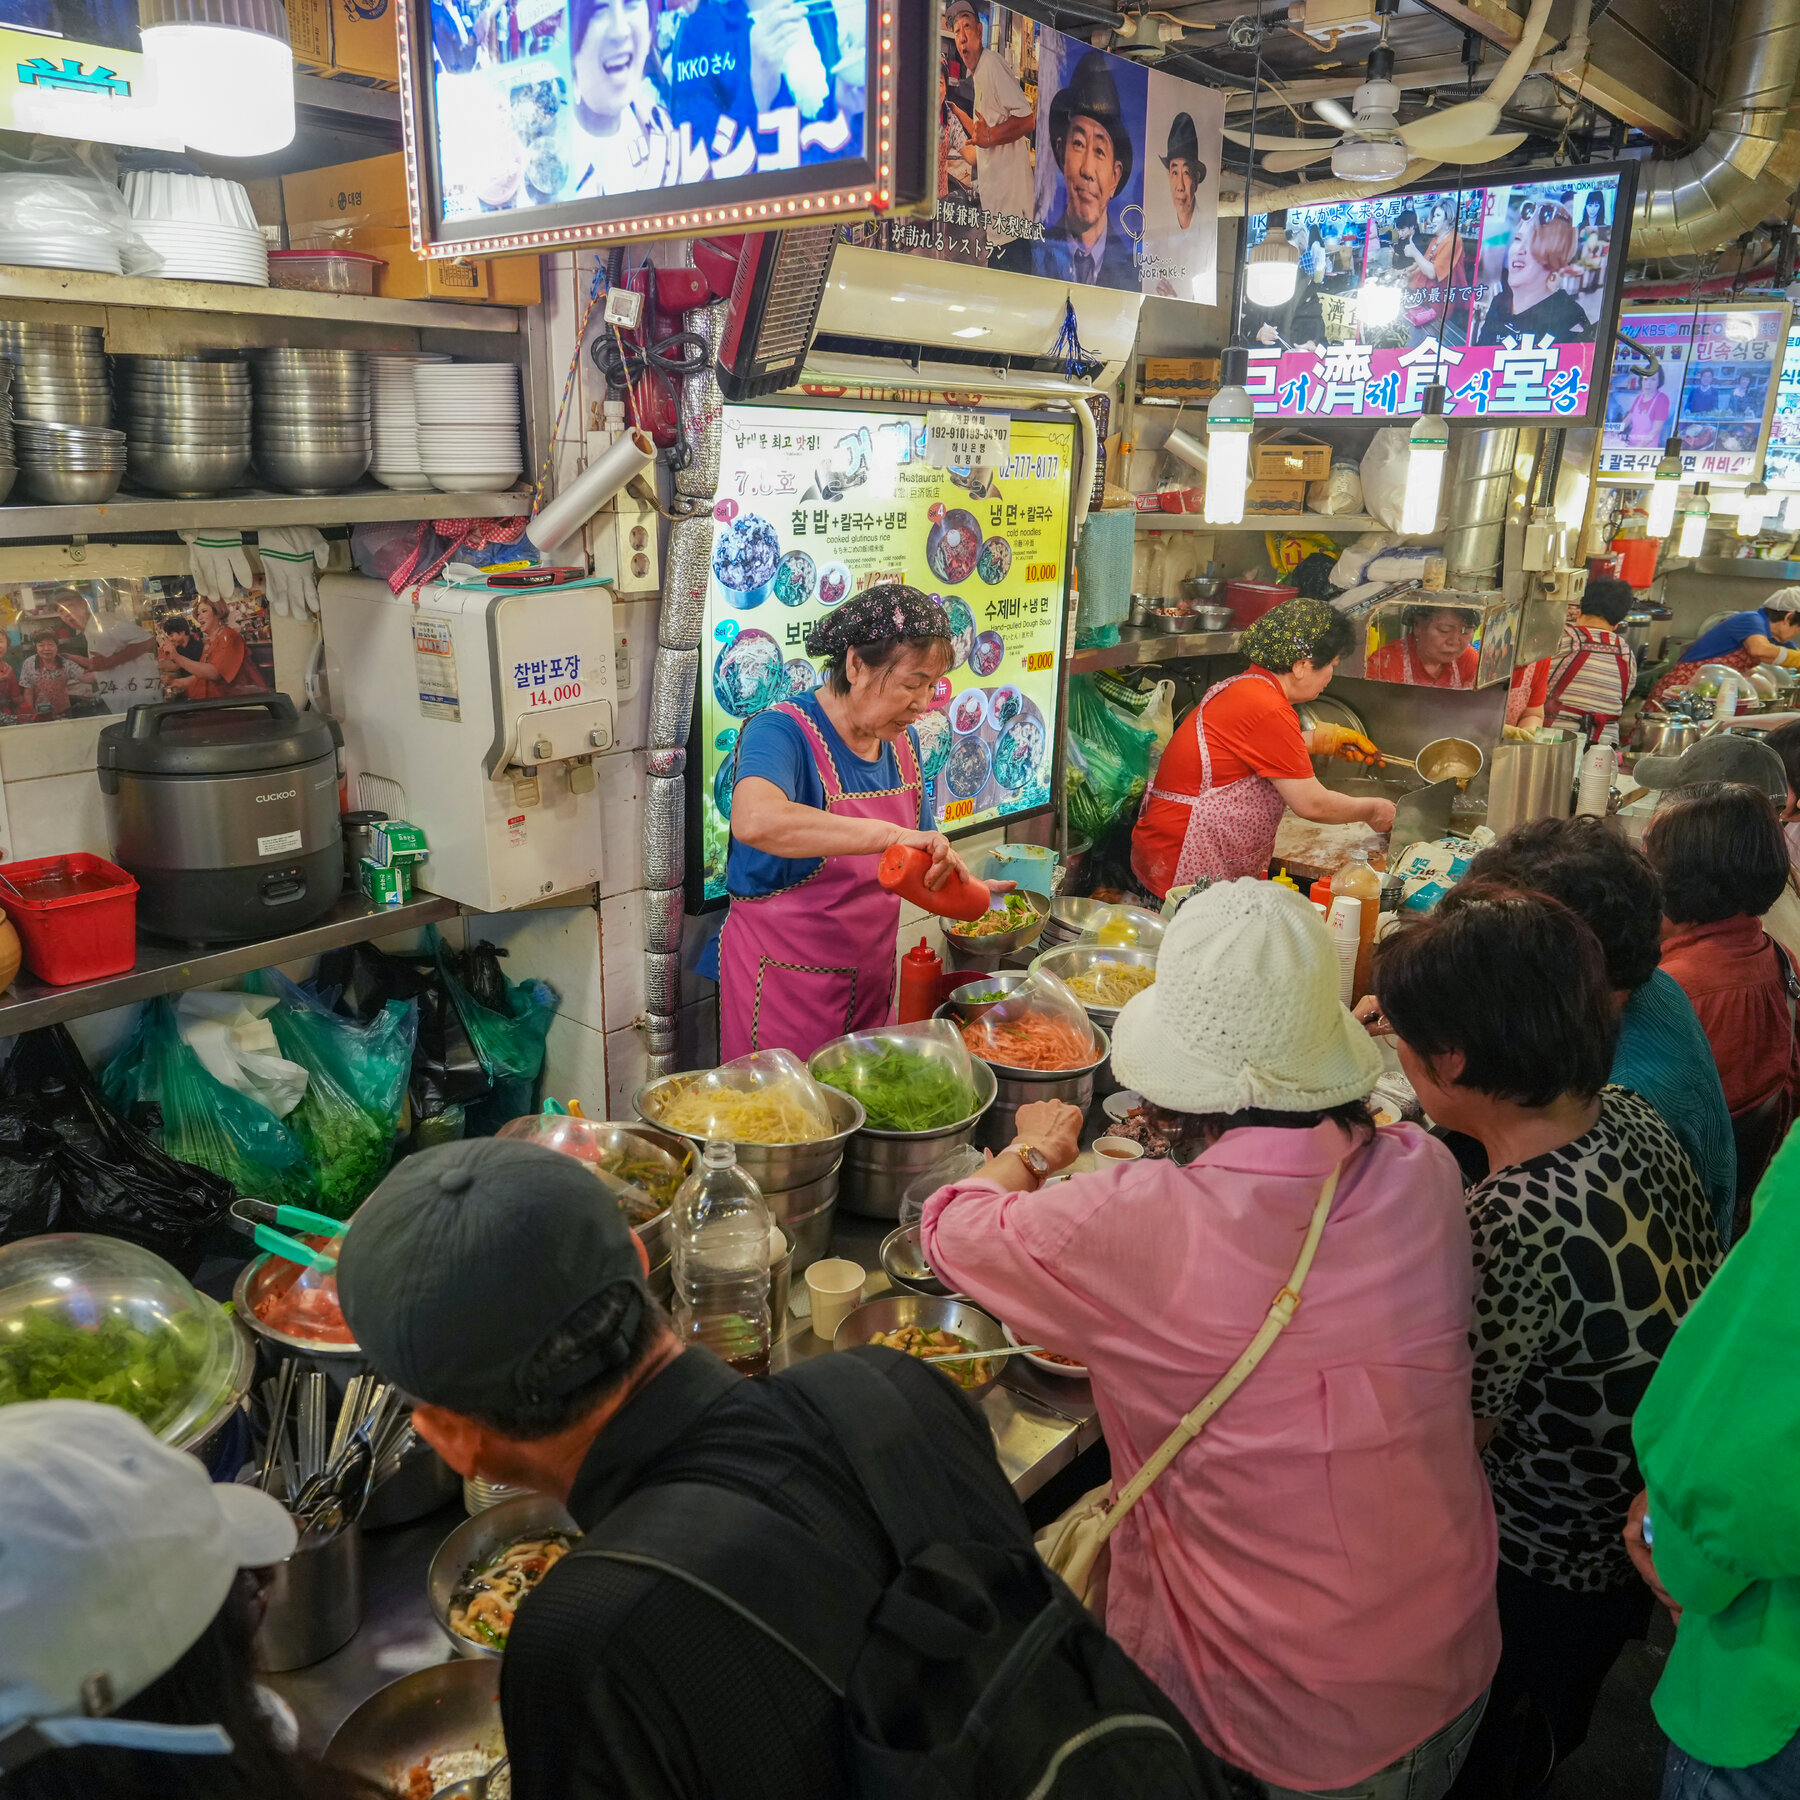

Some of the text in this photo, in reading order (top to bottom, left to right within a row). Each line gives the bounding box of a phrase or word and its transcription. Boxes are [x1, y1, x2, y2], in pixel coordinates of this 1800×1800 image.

[677, 52, 735, 82] IKKOさん
[892, 224, 1006, 260] が訪れるレストラン
[1641, 324, 1666, 337] KBS
[1697, 341, 1770, 362] 민속식당
[771, 433, 793, 450] 최고
[795, 434, 820, 451] 맛집!
[899, 472, 945, 484] Restaurant
[826, 533, 891, 545] cooked glutinous rice
[1006, 528, 1042, 537] cold noodles
[1026, 564, 1057, 582] 10.000
[990, 618, 1052, 632] Hand-pulled Dough Soup
[514, 654, 581, 689] 찰밥포장
[529, 683, 582, 708] 14.000
[255, 789, 297, 803] CUCKOO
